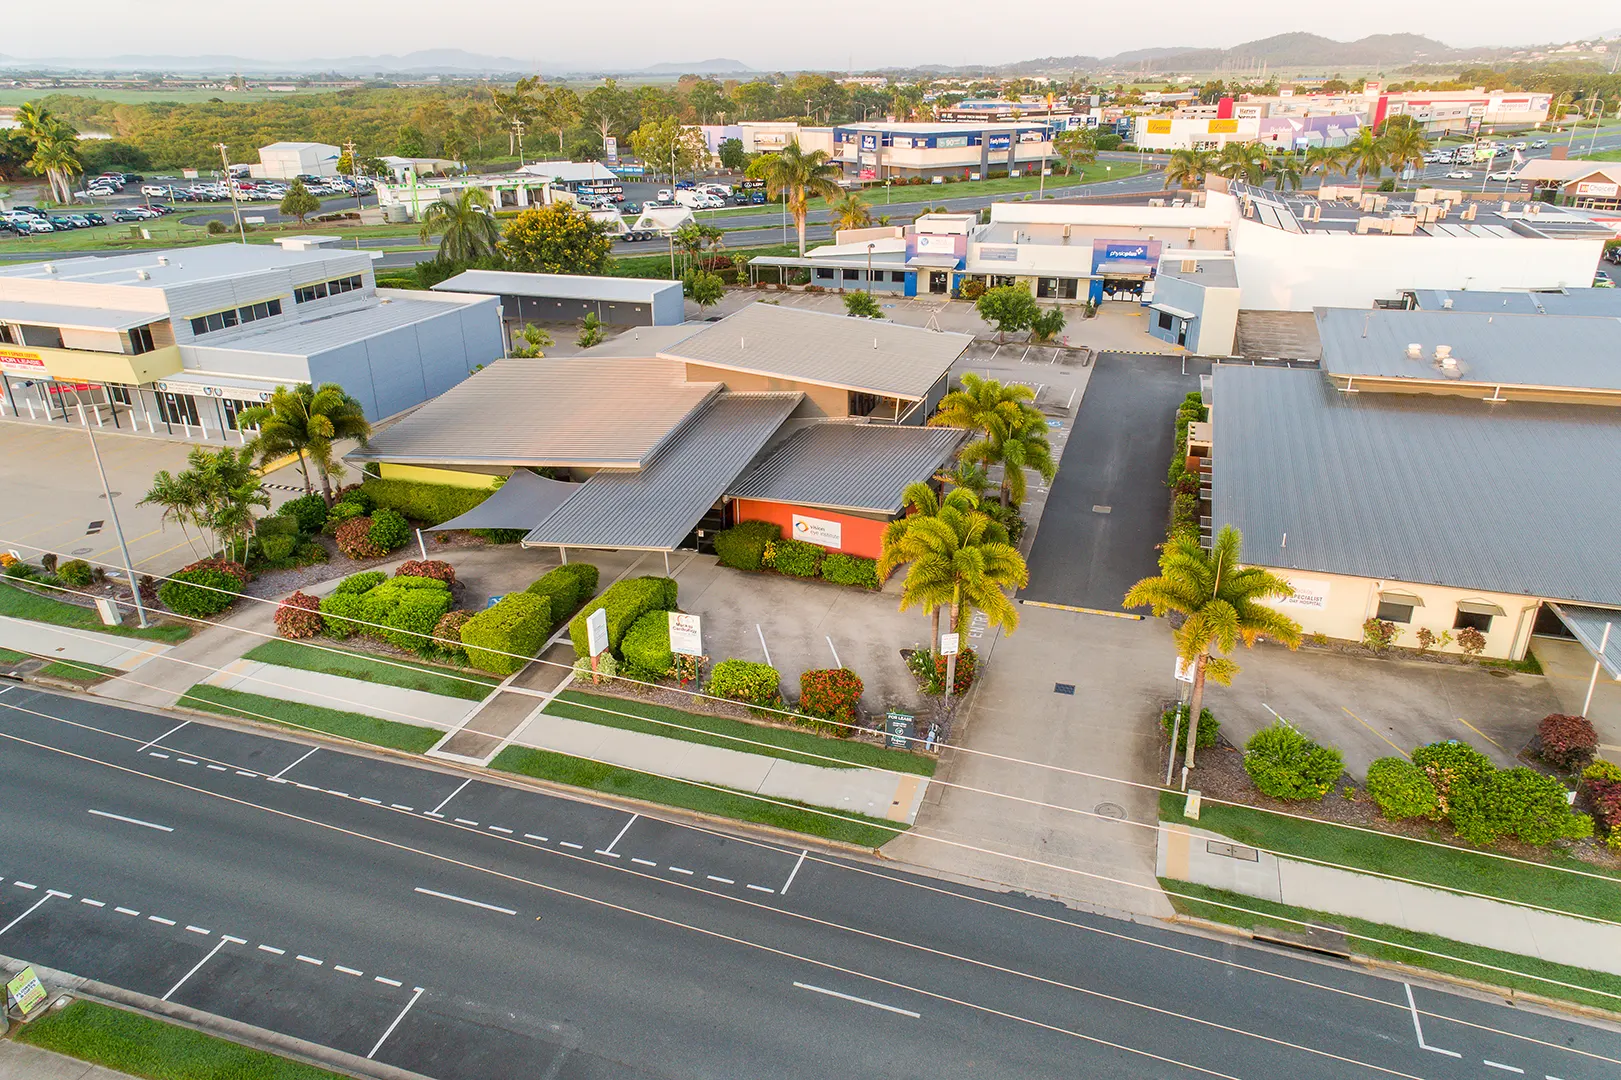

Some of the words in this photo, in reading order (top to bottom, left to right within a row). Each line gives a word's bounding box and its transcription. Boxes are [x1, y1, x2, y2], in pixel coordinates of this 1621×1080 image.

[609, 186, 623, 194] CARS
[1589, 184, 1616, 193] Choices
[1290, 593, 1323, 602] PECIALIST
[968, 610, 988, 638] ENTRY
